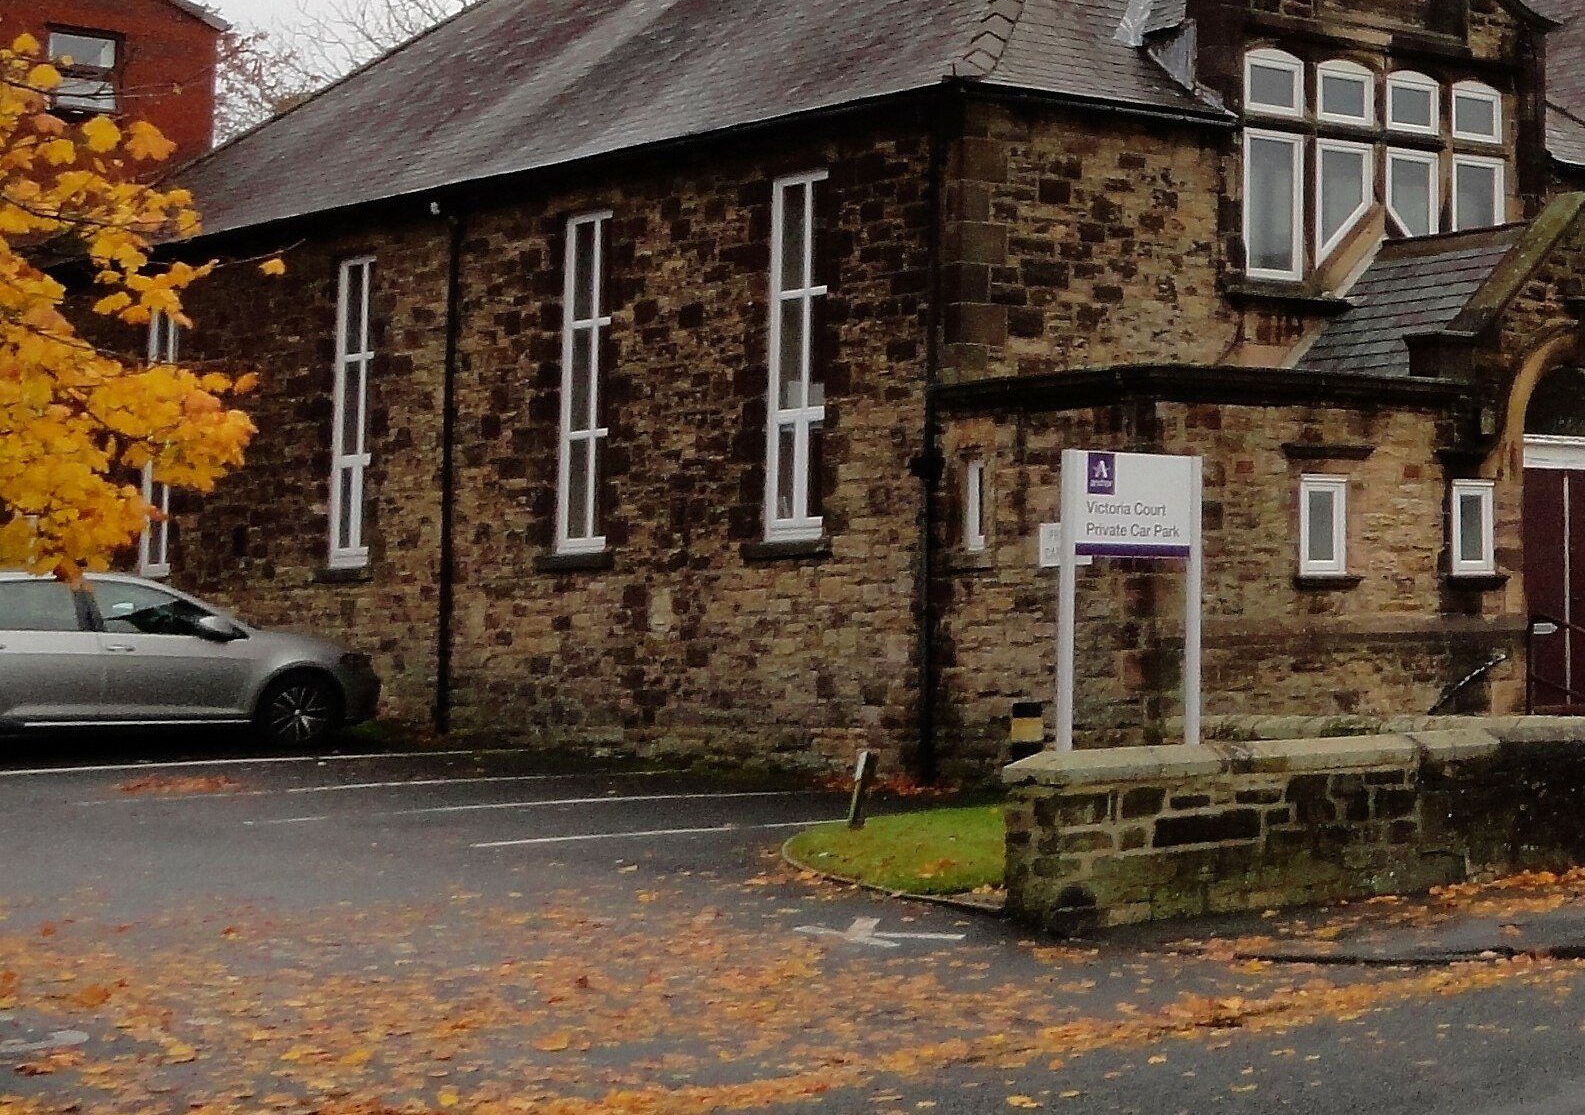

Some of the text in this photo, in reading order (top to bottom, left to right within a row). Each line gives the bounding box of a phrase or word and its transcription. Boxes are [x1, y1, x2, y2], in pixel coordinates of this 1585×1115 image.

[1086, 501, 1167, 516] Victoria Court
[1086, 522, 1180, 538] Private Car Park
